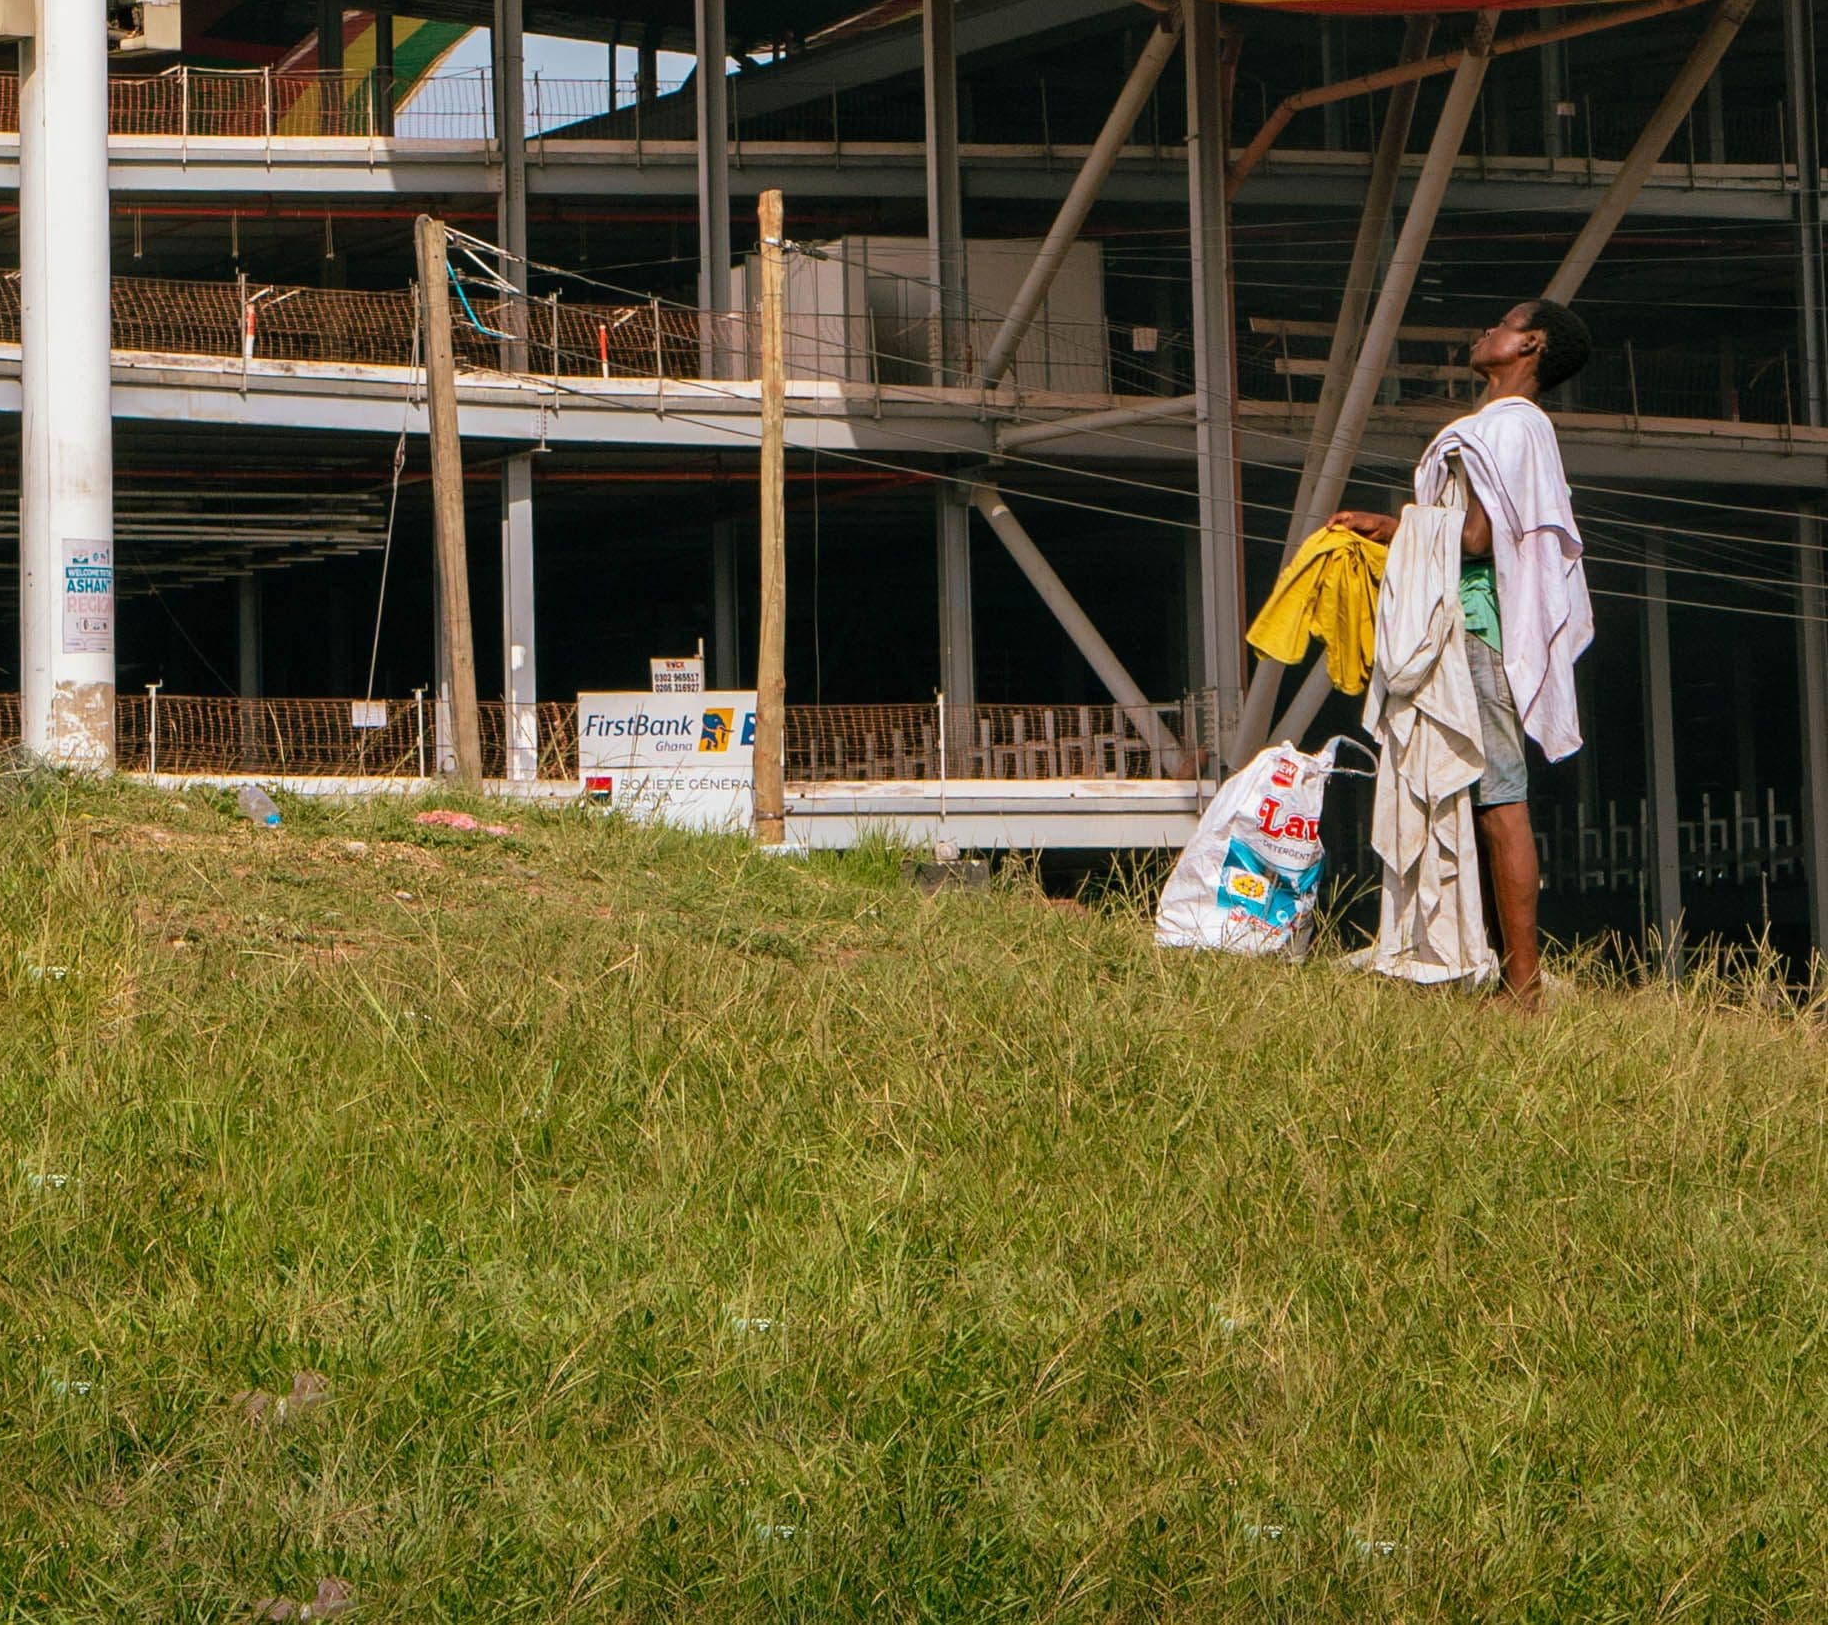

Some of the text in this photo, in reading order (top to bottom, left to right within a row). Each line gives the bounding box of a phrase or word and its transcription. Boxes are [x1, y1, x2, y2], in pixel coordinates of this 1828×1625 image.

[585, 715, 693, 736] FirstBank
[655, 740, 693, 752] Ghana
[1263, 841, 1310, 861] DETERGENT
